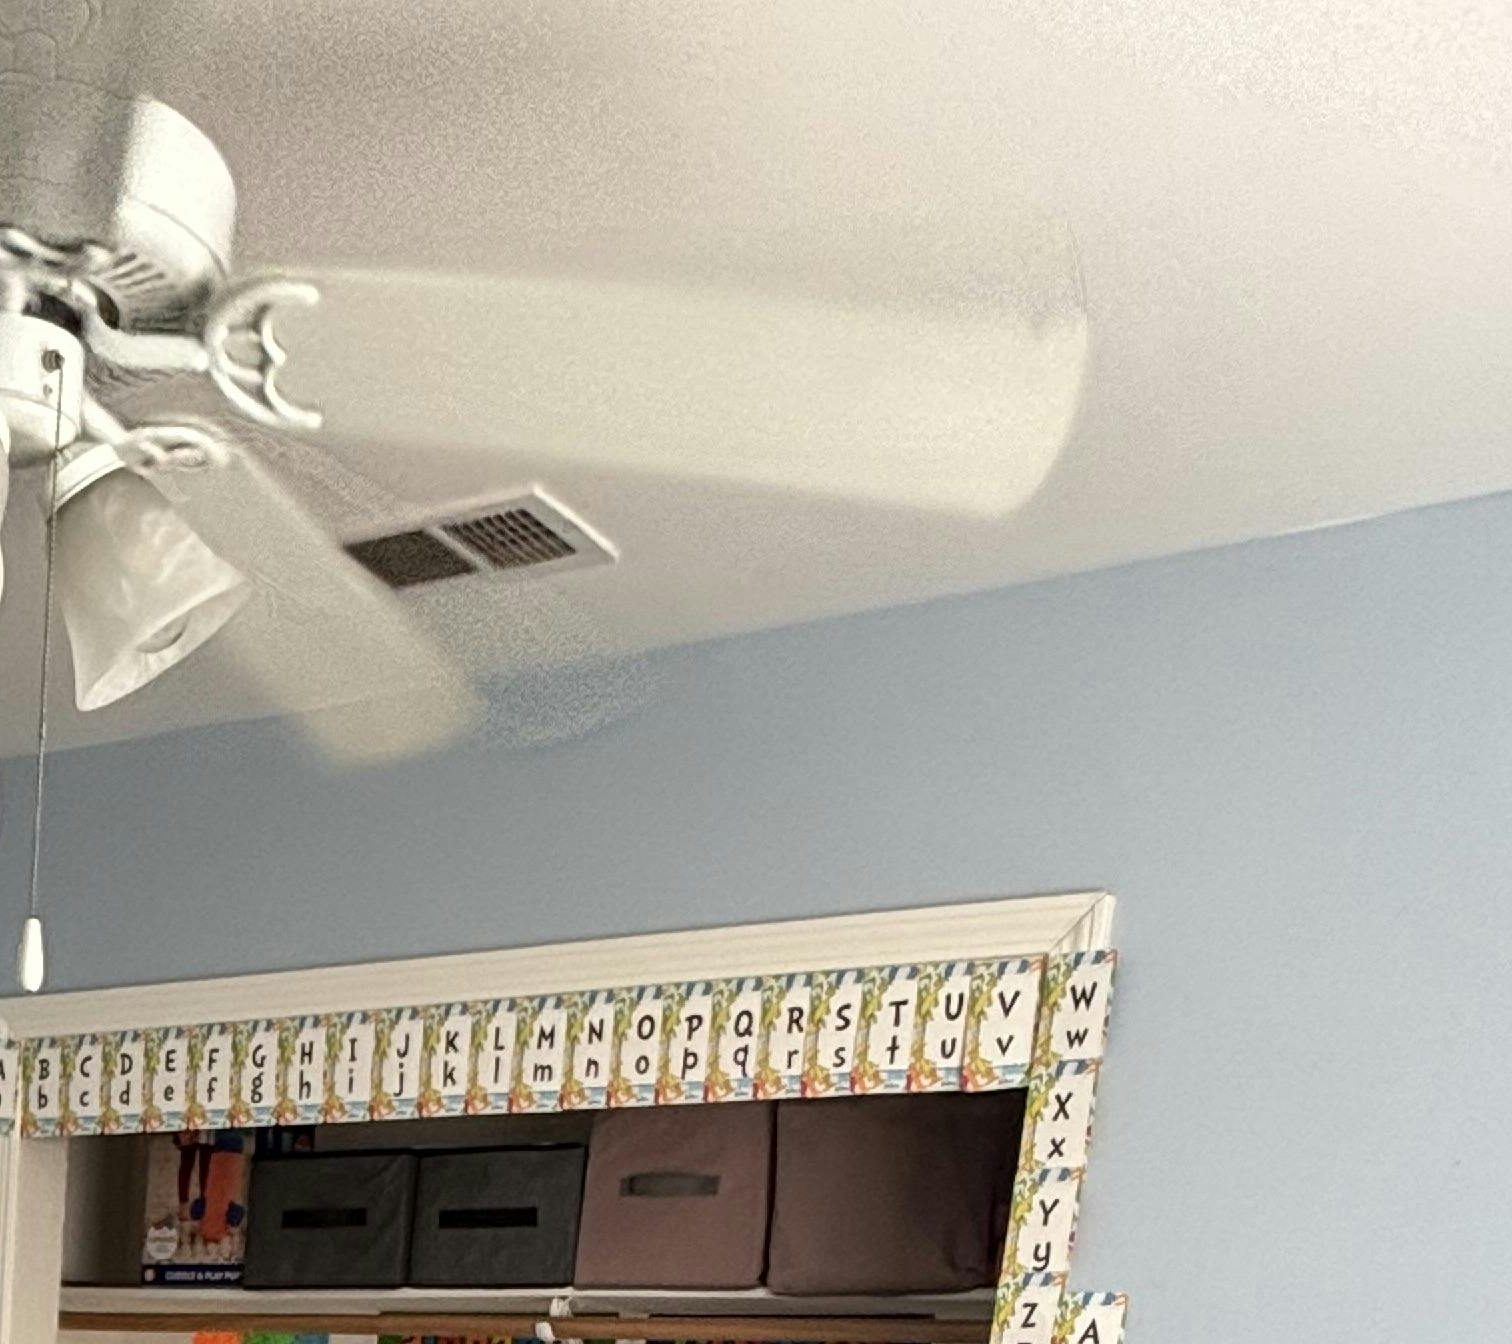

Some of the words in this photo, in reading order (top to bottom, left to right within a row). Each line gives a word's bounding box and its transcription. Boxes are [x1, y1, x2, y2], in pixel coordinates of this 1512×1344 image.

[38, 1058, 50, 1081] B
[80, 1055, 92, 1078] C
[120, 1052, 134, 1076] D
[164, 1048, 177, 1072] E
[208, 1048, 220, 1072] F
[252, 1044, 266, 1068] G
[300, 1041, 314, 1065] H
[349, 1038, 358, 1062] I
[396, 1033, 410, 1058] J
[444, 1030, 459, 1054] K
[494, 1027, 505, 1051] L
[536, 1026, 555, 1050] M
[588, 1018, 604, 1044] N
[637, 1014, 656, 1040] O
[685, 1014, 703, 1041] P
[734, 1010, 754, 1038] Q
[787, 1006, 804, 1034] R
[835, 1003, 852, 1032] S
[890, 999, 909, 1027] T
[944, 992, 964, 1021] U
[998, 990, 1020, 1018] V
[1070, 982, 1098, 1011] W
[1052, 1092, 1073, 1122] X
[1039, 1198, 1060, 1226] Y
[1021, 1302, 1038, 1328] Z
